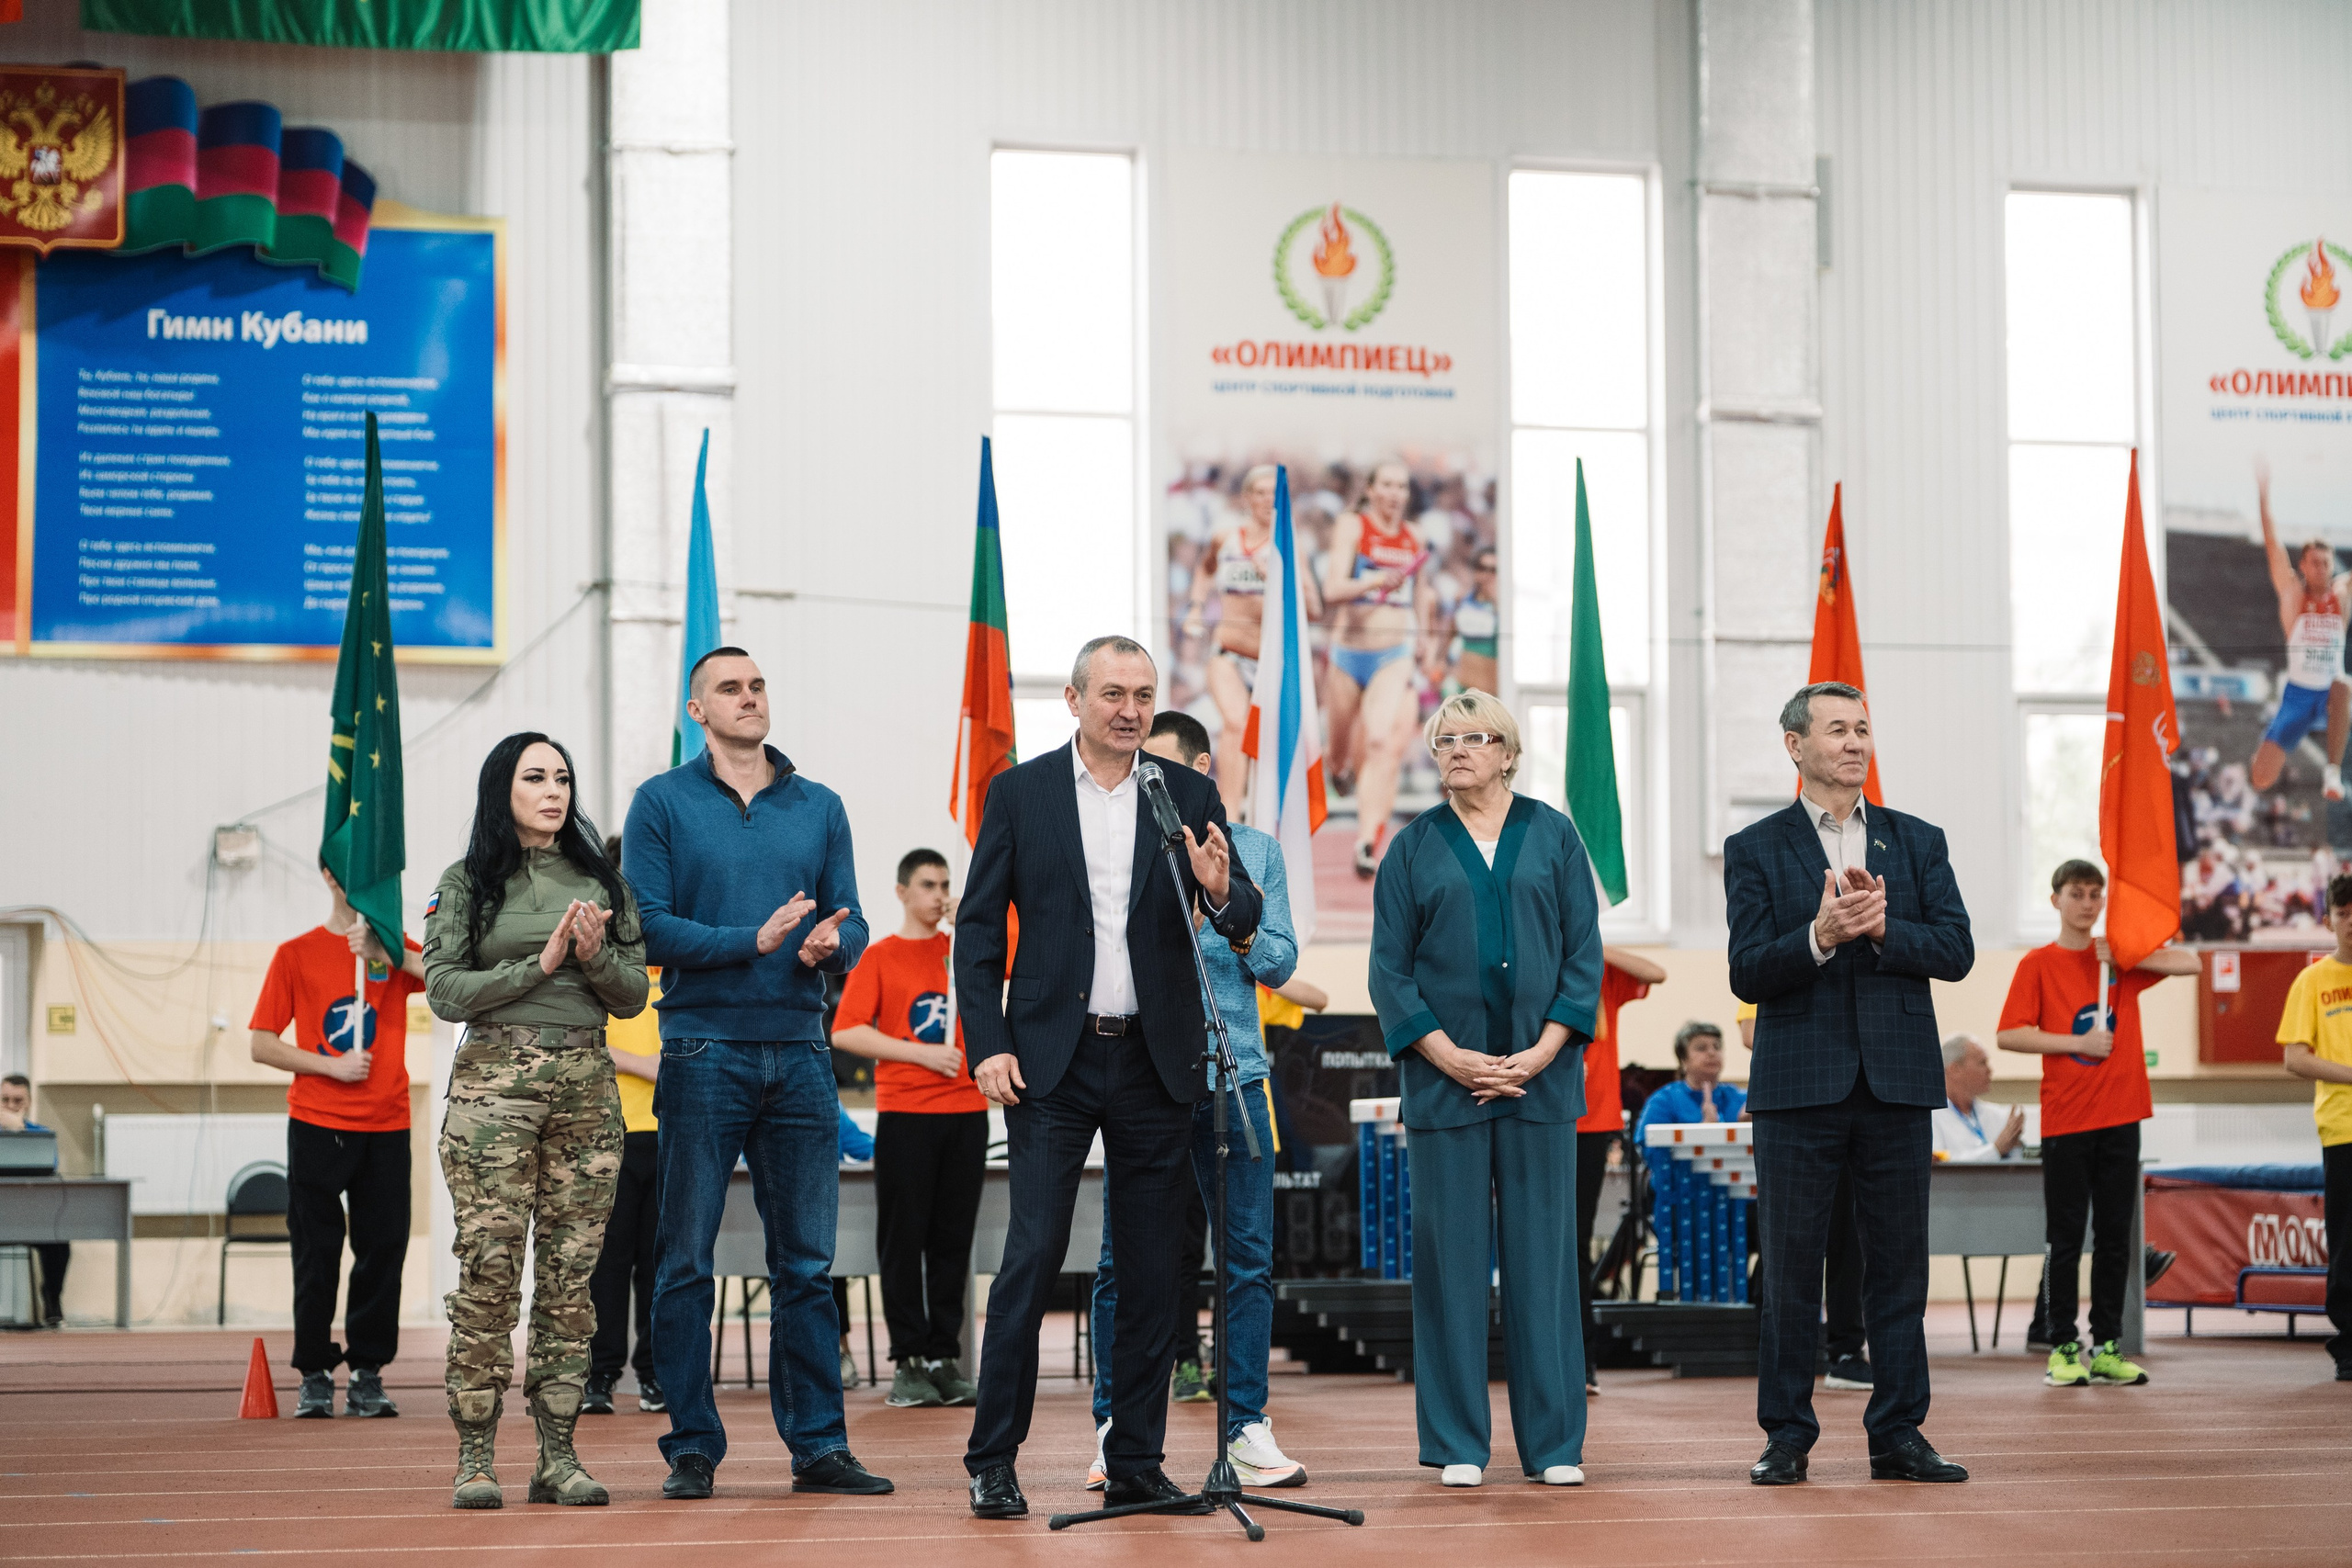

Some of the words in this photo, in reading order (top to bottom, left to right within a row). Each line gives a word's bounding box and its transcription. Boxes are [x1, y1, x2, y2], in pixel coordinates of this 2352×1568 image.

[147, 308, 234, 341] Гимн
[241, 310, 368, 350] Кубани
[1212, 340, 1453, 379] «ОЛИМПИЕЦ»
[2210, 367, 2352, 398] «ОЛИМП
